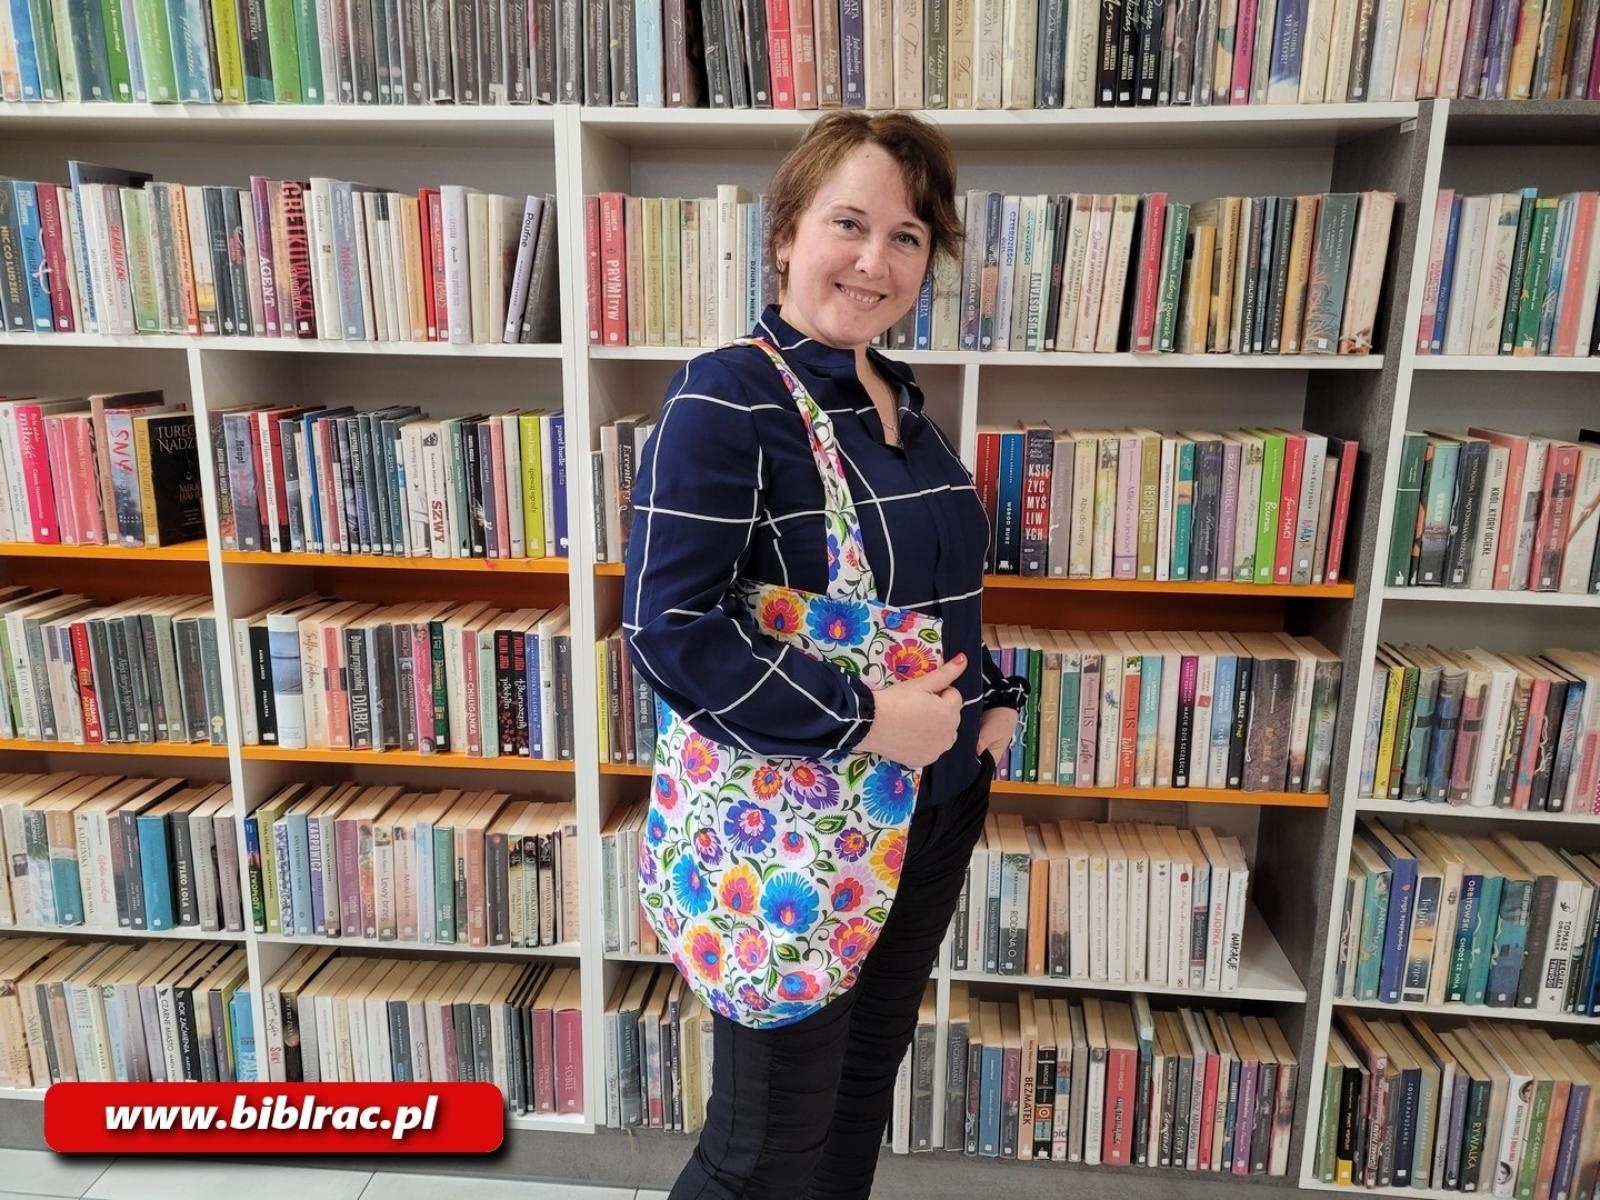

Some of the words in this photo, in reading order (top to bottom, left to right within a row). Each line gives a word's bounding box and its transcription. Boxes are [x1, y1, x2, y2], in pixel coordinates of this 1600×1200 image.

[520, 211, 535, 249] Poufne
[4, 243, 13, 260] CO
[6, 262, 21, 305] LUDZKIE
[258, 255, 276, 308] AGENT
[605, 259, 623, 321] PRYMITYW
[1168, 274, 1178, 300] Leśny
[1027, 274, 1042, 335] PUSTOSTANY
[1163, 302, 1175, 337] Dworek
[111, 429, 134, 474] SNY
[557, 446, 566, 468] huelle
[1026, 480, 1046, 494] ŻYC
[1025, 496, 1048, 509] MYŚ
[1079, 497, 1089, 513] Aby
[430, 500, 446, 545] SZWY
[1025, 511, 1044, 526] LIW
[1079, 514, 1087, 526] do
[1025, 527, 1043, 541] YCH
[1482, 532, 1494, 557] UCIEKŁ
[83, 696, 93, 726] MARGOT
[351, 694, 370, 735] DIABŁA
[467, 682, 477, 735] CHULIGANKA
[1082, 707, 1096, 728] LIS
[1124, 709, 1138, 730] LIS
[309, 822, 322, 873] KARPOWICZ
[178, 860, 187, 886] TYLKO
[180, 887, 190, 908] LOLA
[380, 877, 391, 900] Lewy
[1461, 879, 1476, 932] ORBITOWSKI
[1008, 910, 1019, 948] RODZINA
[1212, 902, 1223, 946] MAJORKA
[1554, 920, 1564, 952] ORGANEK
[1559, 920, 1572, 952] TOMASZ
[1226, 932, 1242, 971] WAKACJE
[161, 999, 172, 1025] CZARNE
[177, 1000, 188, 1015] ROK
[165, 1026, 175, 1052] MIASTO
[563, 1064, 577, 1092] SOBIE
[1021, 1077, 1036, 1126] BEZMATEK
[1466, 1121, 1483, 1171] RYWALKA
